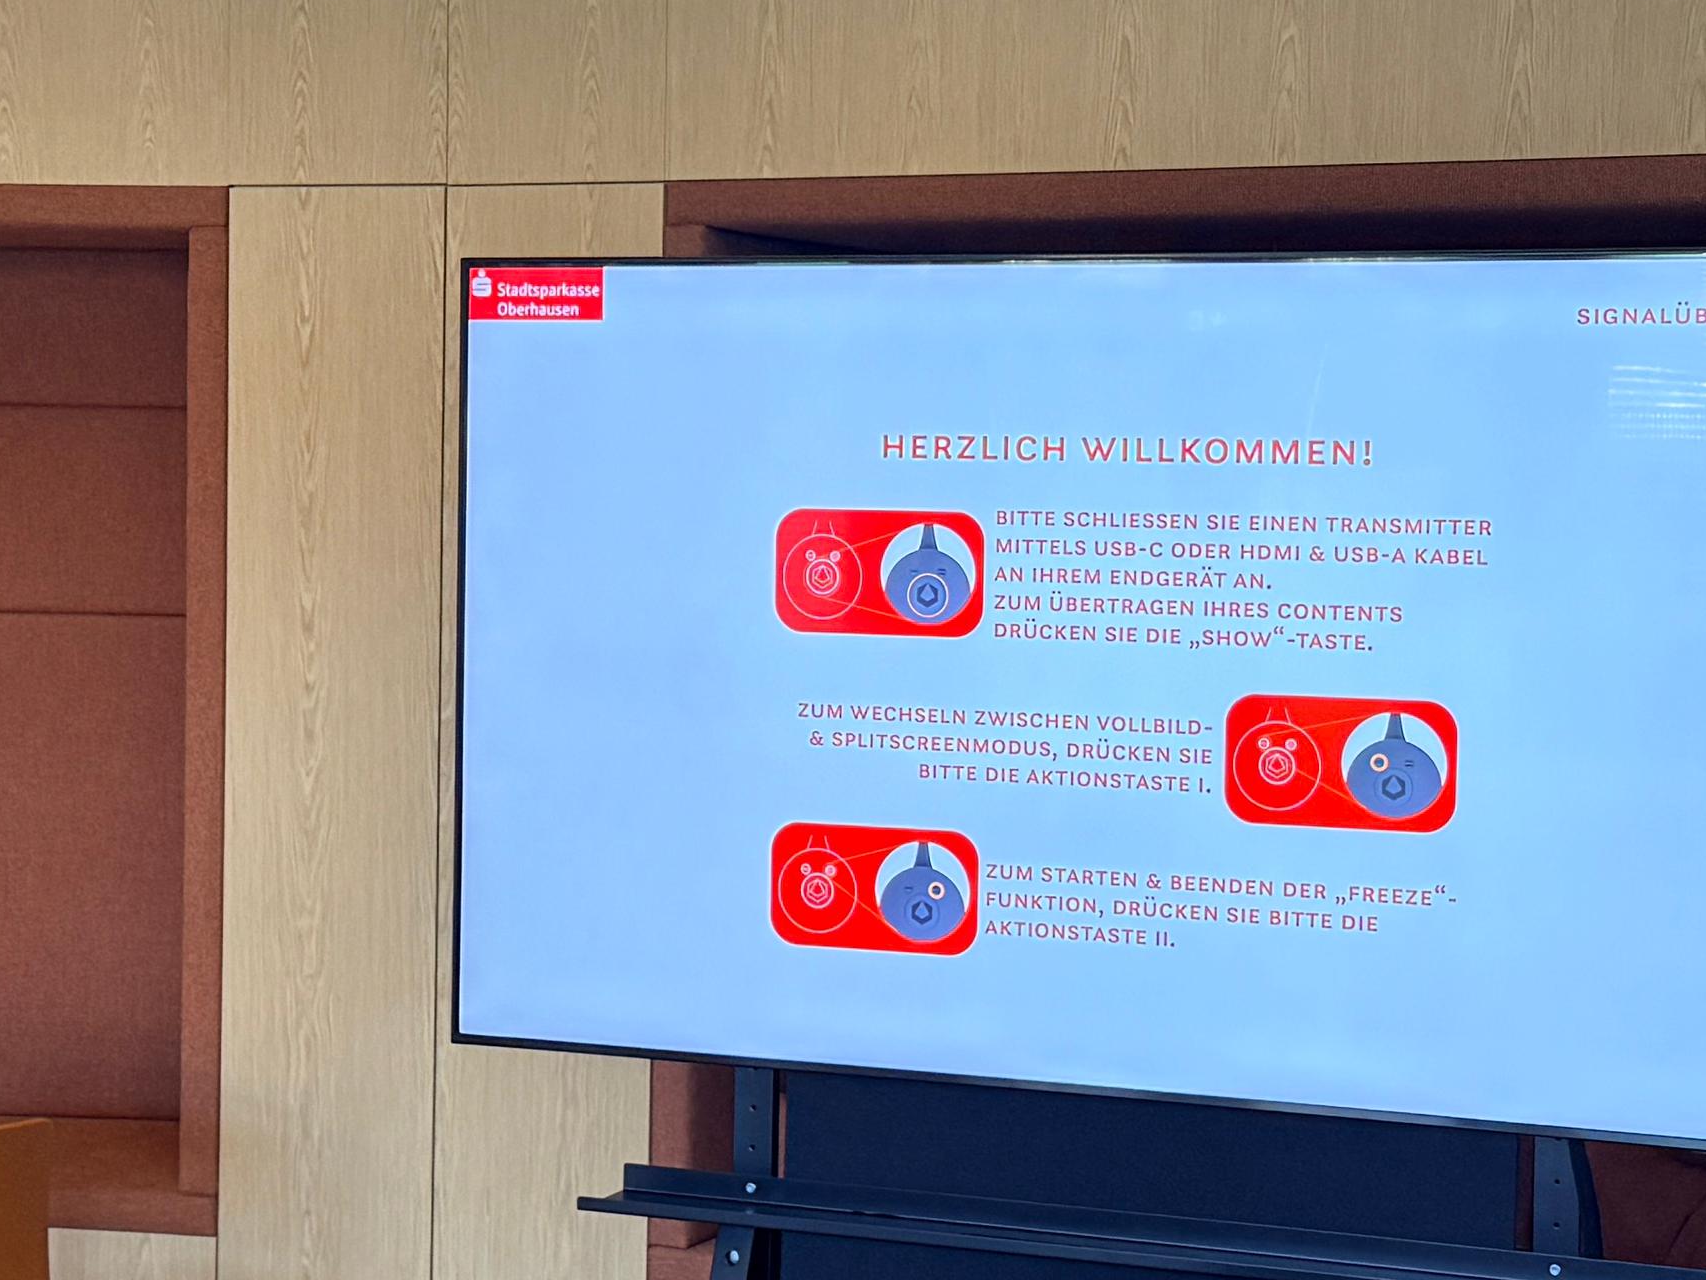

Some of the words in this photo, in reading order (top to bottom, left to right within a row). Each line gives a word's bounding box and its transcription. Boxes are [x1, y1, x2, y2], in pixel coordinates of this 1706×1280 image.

[498, 283, 599, 299] Stadtsparkasse
[498, 302, 579, 316] Oberhausen
[883, 434, 1064, 461] HERZLICH
[1082, 437, 1374, 466] WILLKOMMEN!
[997, 511, 1055, 526] BITTE
[1064, 512, 1197, 529] SCHLIESSEN
[1207, 514, 1240, 530] SIE
[1249, 515, 1316, 532] EINEN
[1325, 517, 1491, 536] TRANSMITTER
[996, 538, 1086, 556] MITTELS
[1095, 540, 1163, 558] USB-C
[1171, 543, 1230, 560] ODER
[1241, 544, 1299, 561] HDMI
[1309, 546, 1325, 561] &
[1335, 546, 1406, 564] USB-A
[1415, 548, 1488, 565] KABEL
[994, 566, 1023, 582] AN
[1033, 568, 1100, 584] IHREM
[1111, 566, 1227, 588] ENDGERÄT
[1233, 573, 1272, 590] AN.
[994, 595, 1040, 611] ZUM
[1050, 591, 1194, 616] ÜBERTRAGEN
[1204, 601, 1268, 618] IHRES
[1278, 603, 1402, 622] CONTENTS
[994, 618, 1096, 641] DRÜCKEN
[1105, 626, 1137, 643] SIE
[1147, 628, 1181, 644] DIE
[798, 703, 842, 719] ZUM
[850, 705, 965, 725] WECHSELN
[974, 710, 1088, 731] ZWISCHEN
[1096, 716, 1213, 735] VOLLBILD-
[810, 731, 824, 746] &
[832, 732, 1057, 762] SPLITSCREENMODUS,
[1067, 738, 1170, 763] DRÜCKEN
[1179, 748, 1212, 764] SIE
[919, 764, 977, 781] BITTE
[986, 767, 1019, 783] DIE
[1026, 769, 1189, 792] AKTIONSTASTE
[1199, 777, 1211, 794] I.
[986, 864, 1032, 881] ZUM
[1041, 867, 1136, 888] STARTEN
[1146, 873, 1161, 889] &
[1171, 875, 1273, 896] BEENDEN
[1284, 882, 1326, 899] DER
[987, 892, 1103, 918] FUNKTION,
[1114, 896, 1217, 922] DRÜCKEN
[1227, 907, 1260, 924] SIE
[1270, 910, 1332, 929] BITTE
[1342, 915, 1378, 932] DIE
[985, 920, 1146, 945] AKTIONSTASTE
[1156, 931, 1175, 947] II.
